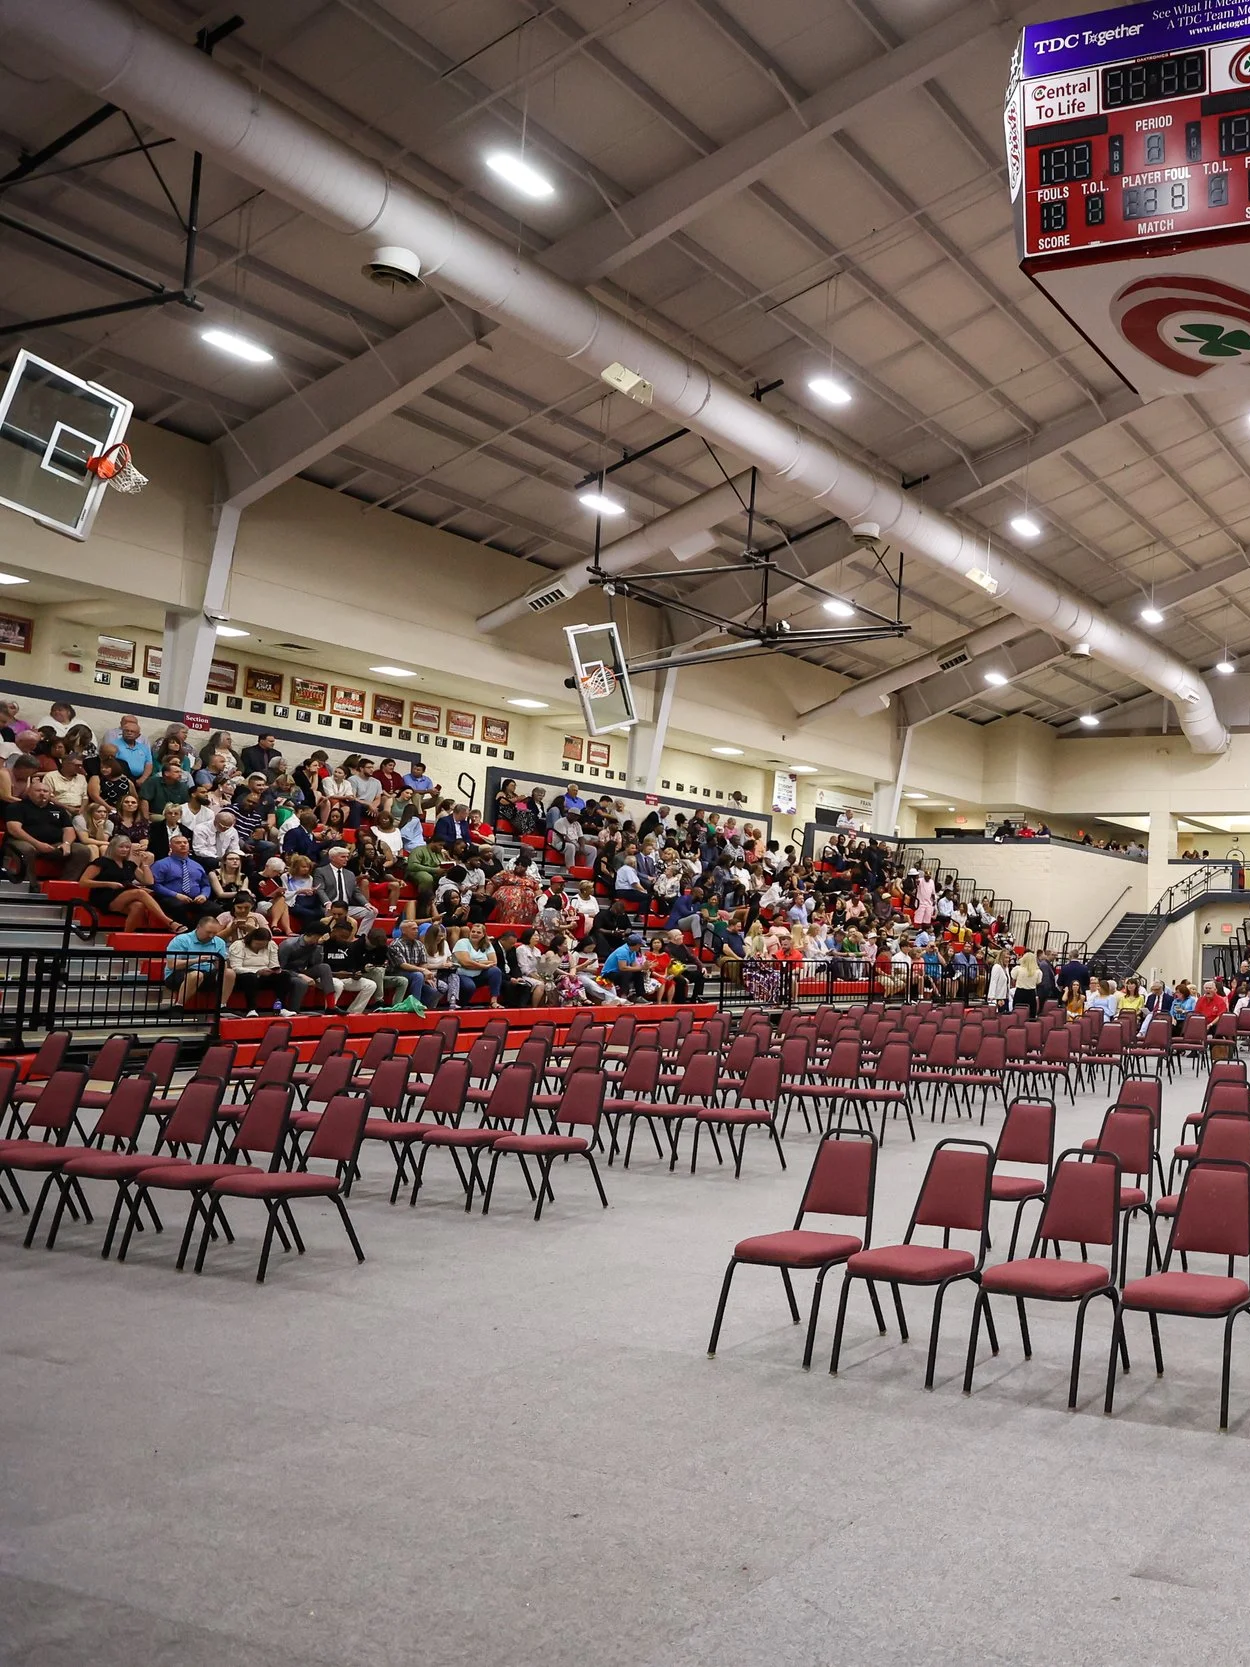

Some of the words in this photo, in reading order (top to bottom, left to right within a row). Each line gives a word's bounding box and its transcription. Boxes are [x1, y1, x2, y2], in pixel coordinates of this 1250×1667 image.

[1152, 9, 1171, 20] See
[1173, 4, 1201, 16] What
[1203, 1, 1213, 10] It
[1167, 19, 1175, 30] A
[1177, 14, 1202, 27] TDC
[1204, 10, 1234, 22] Team
[1034, 33, 1080, 55] TDC
[1031, 77, 1091, 102] Central
[1036, 104, 1054, 120] To
[1058, 99, 1086, 116] Life
[1135, 115, 1173, 132] PERIOD
[1202, 161, 1232, 175] T.O.L.
[1122, 171, 1161, 188] PLAYER
[1164, 166, 1191, 182] FOUL
[1037, 186, 1069, 202] FOULS
[1081, 180, 1109, 195] T.O.L.
[1137, 219, 1174, 235] MATCH
[1038, 235, 1070, 250] SCORE
[186, 715, 209, 723] Section
